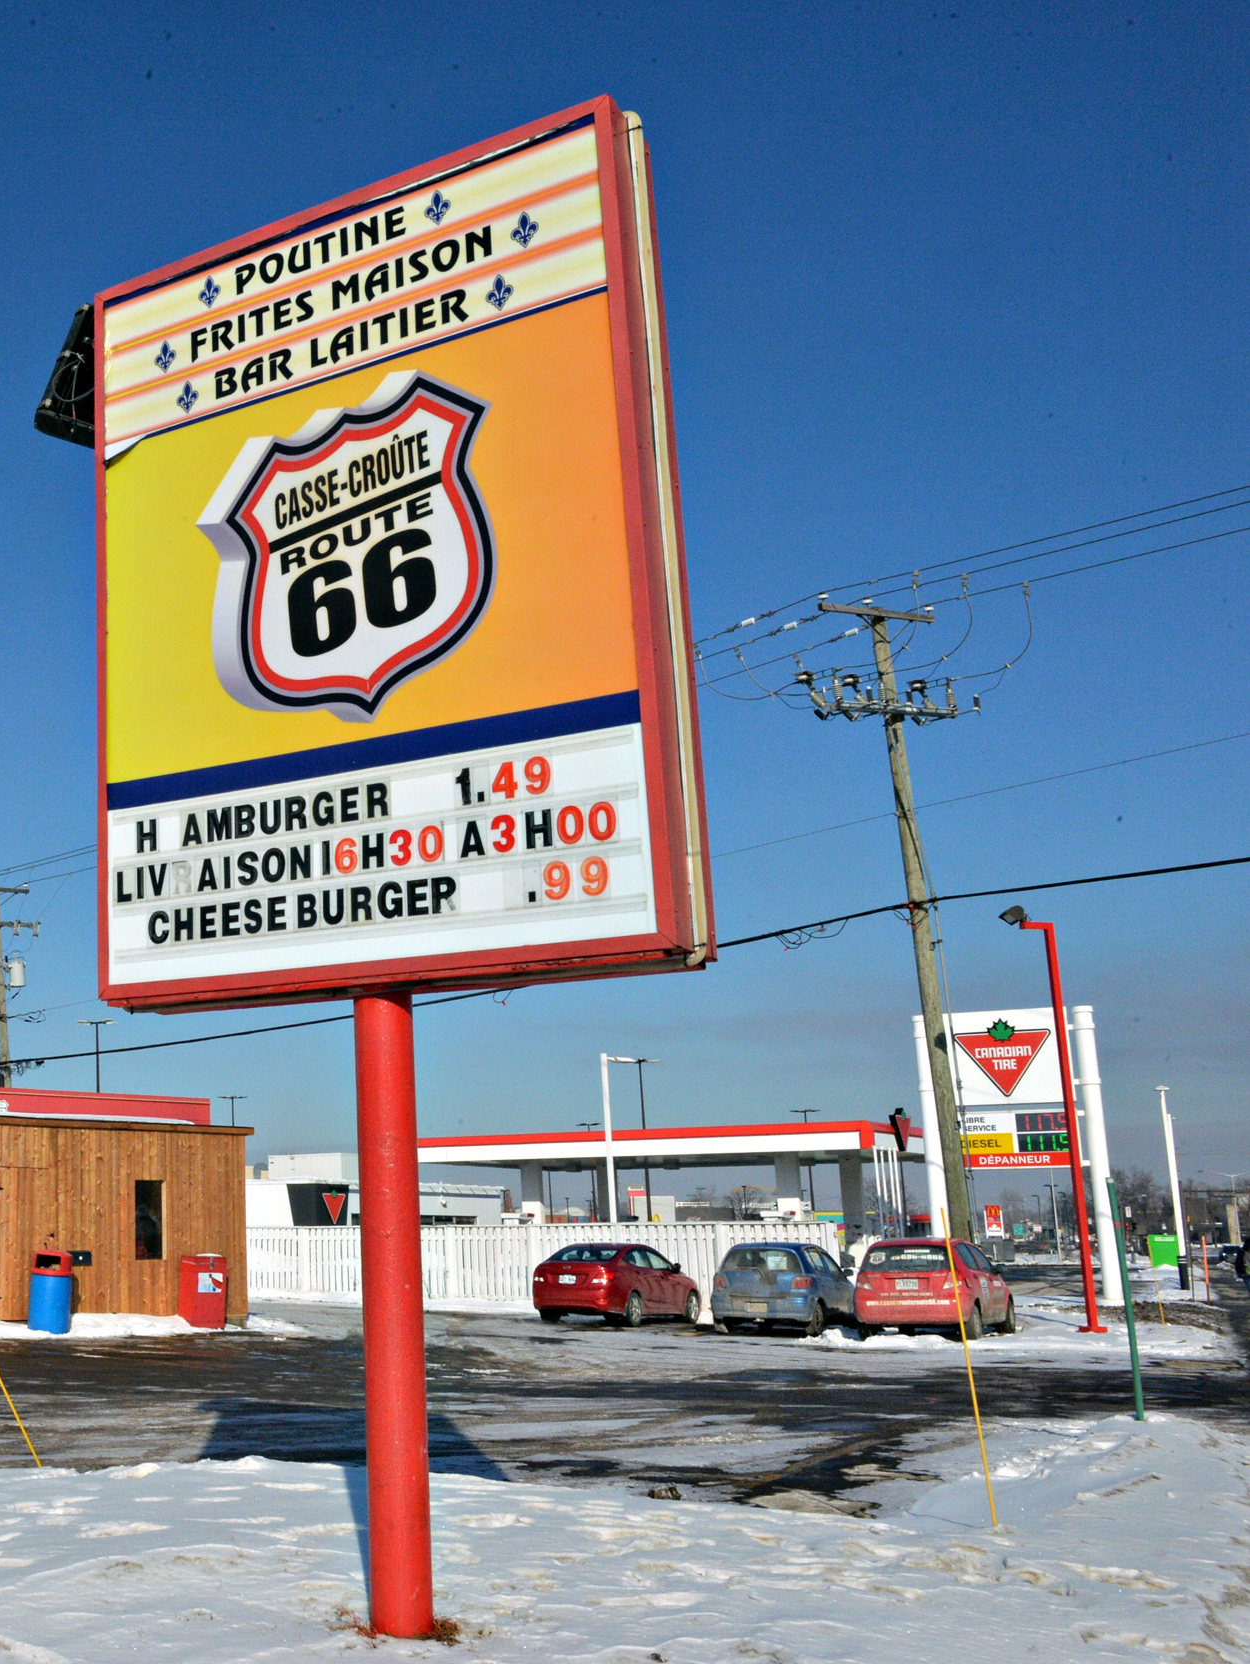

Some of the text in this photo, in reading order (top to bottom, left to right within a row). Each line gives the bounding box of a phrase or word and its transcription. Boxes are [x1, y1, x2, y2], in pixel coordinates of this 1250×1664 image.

[235, 206, 407, 295] POUTINE
[191, 226, 492, 363] FRITES MAISON
[215, 289, 468, 399] BAR LAITIER
[275, 429, 431, 530] CASSE-CROÛTE
[280, 492, 434, 576] ROUTE
[287, 528, 437, 657] 66
[455, 756, 551, 806] 1.49
[528, 855, 609, 903] .99
[975, 1046, 1032, 1058] CANADIAN
[992, 1059, 1017, 1070] TIRE
[979, 1155, 1051, 1165] DÉPANNEUR
